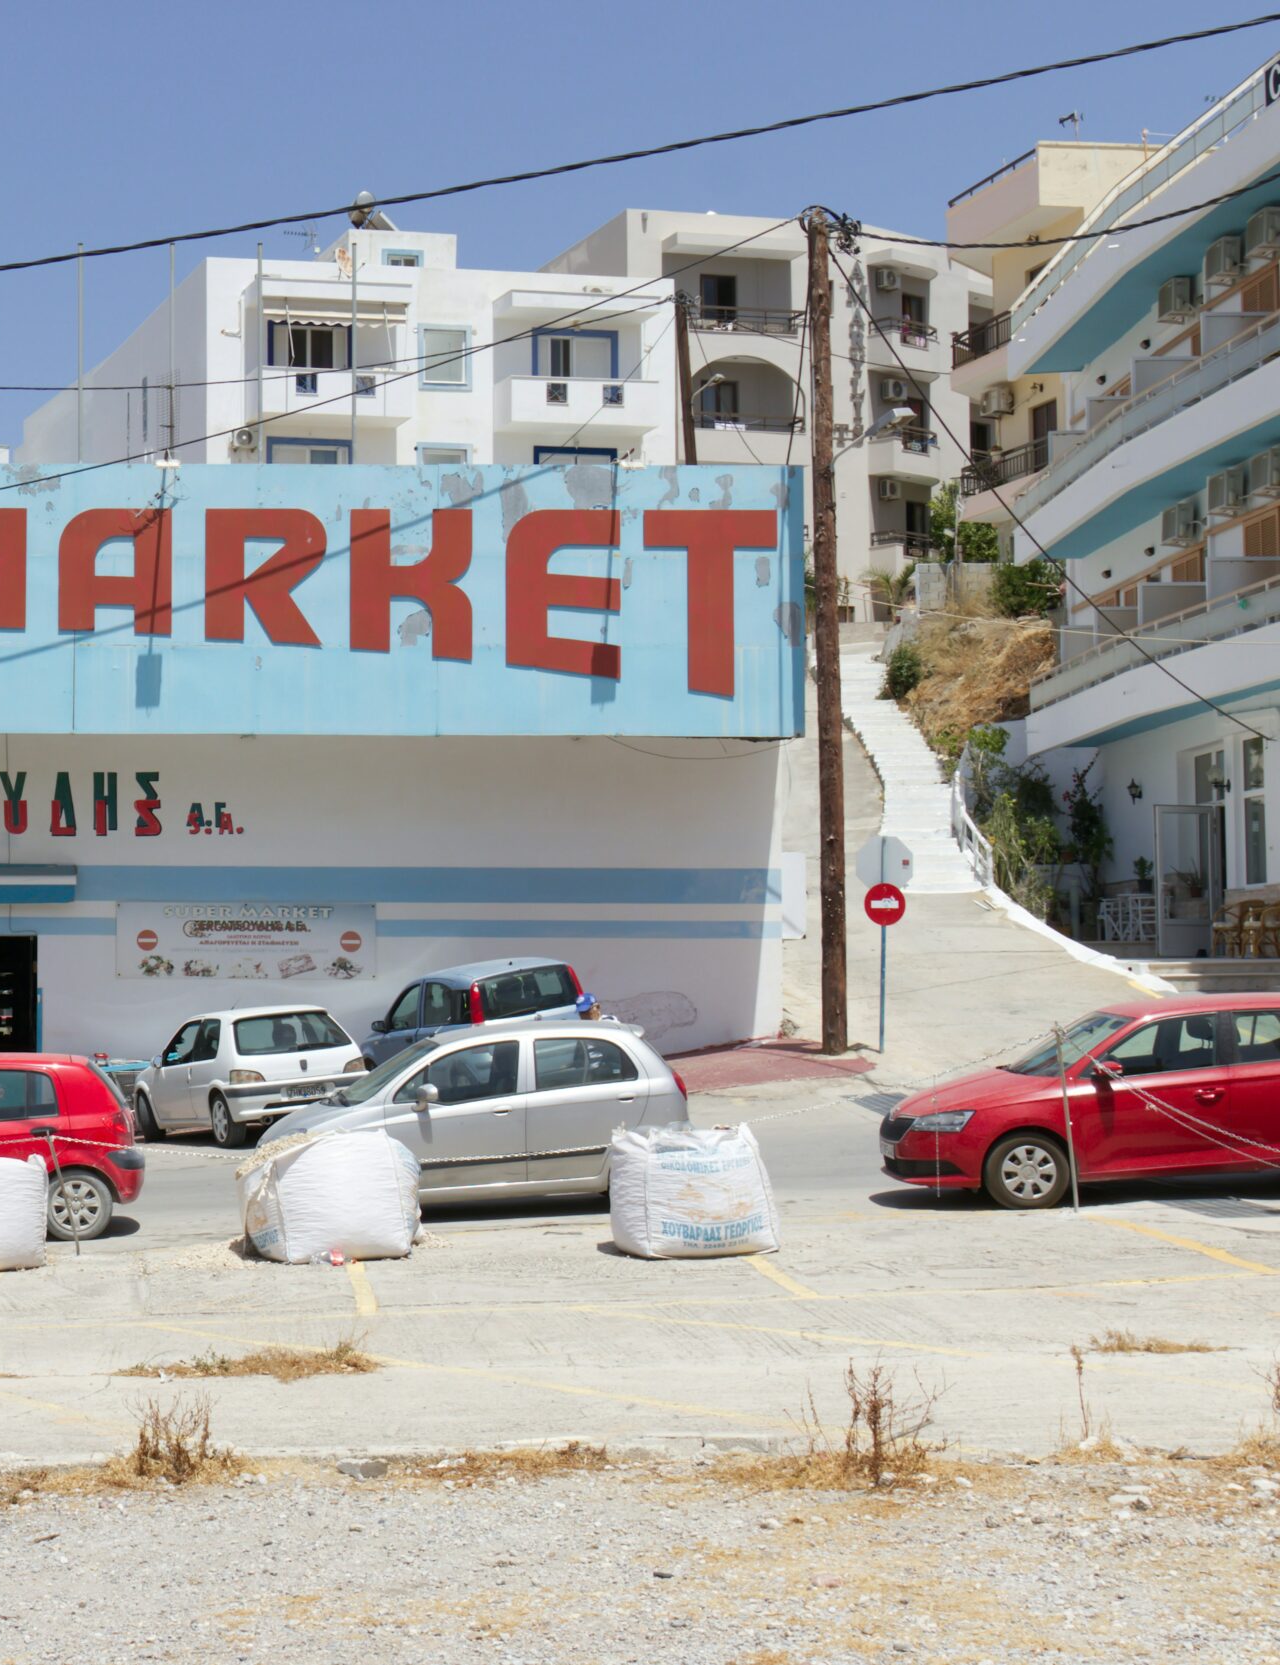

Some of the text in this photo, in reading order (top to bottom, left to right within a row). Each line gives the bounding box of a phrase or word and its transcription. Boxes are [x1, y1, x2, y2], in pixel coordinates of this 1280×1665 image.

[162, 904, 334, 920] SUPER MARKET
[661, 1215, 765, 1242] ΧΟΥΒΑΡΔΑΣ ΓΕΩΡΓΙΟΣ
